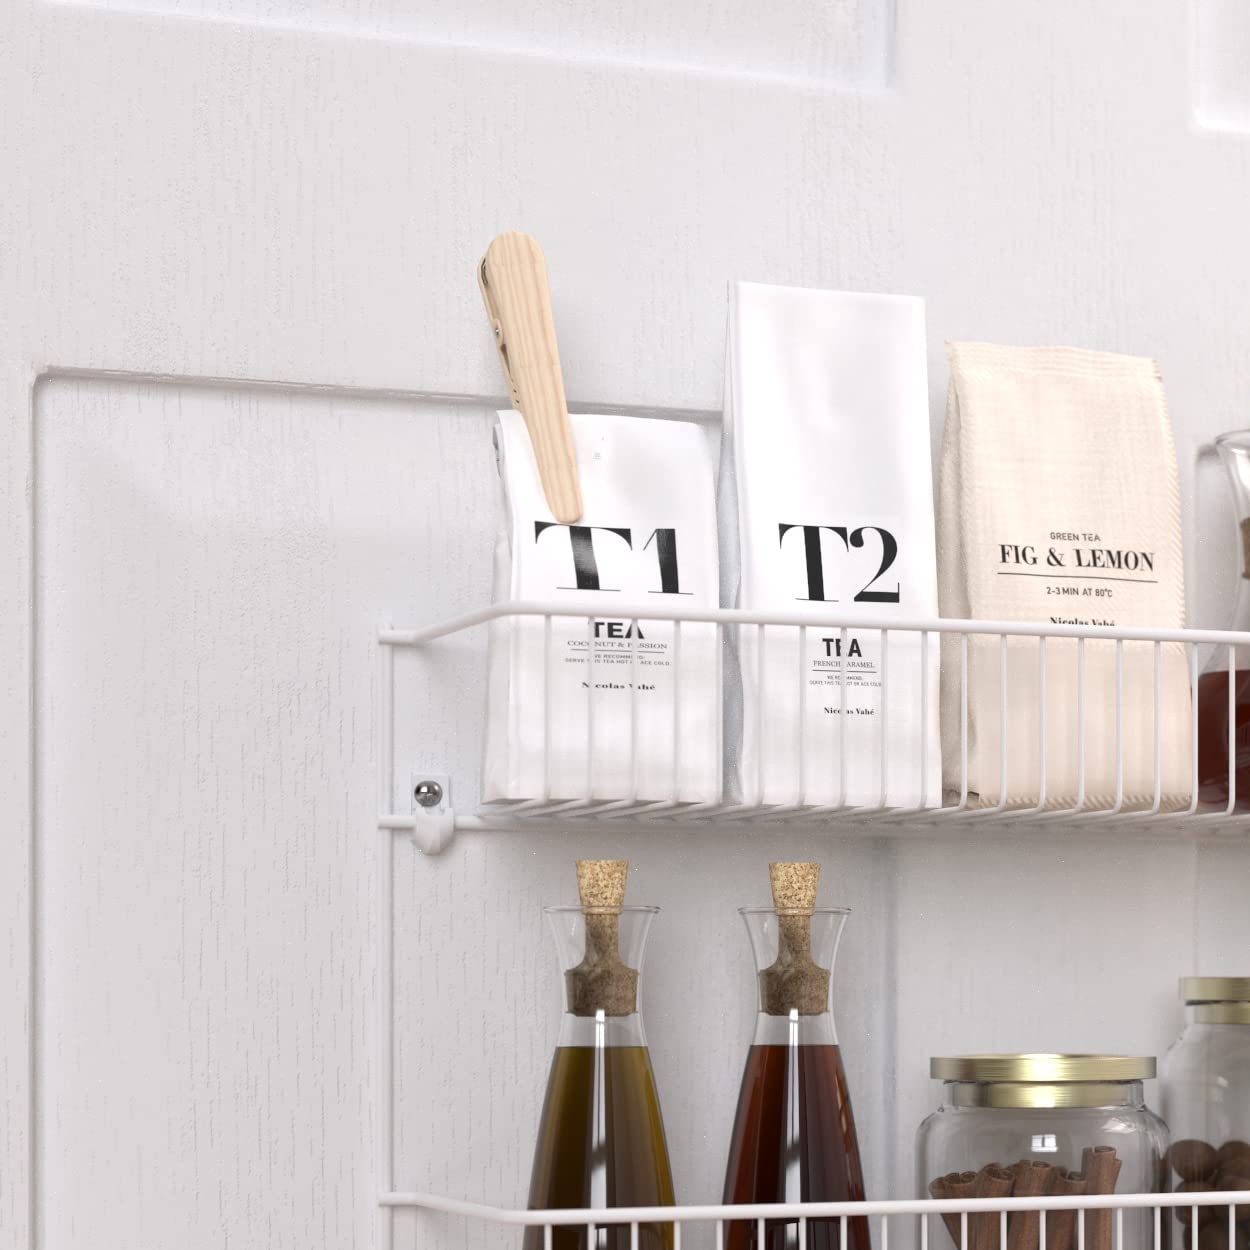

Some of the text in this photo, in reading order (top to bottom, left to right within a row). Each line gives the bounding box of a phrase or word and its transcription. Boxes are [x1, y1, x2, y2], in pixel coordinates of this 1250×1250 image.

[1050, 532, 1101, 542] GREEN TEA
[534, 520, 694, 595] T1
[778, 523, 900, 603] T2
[998, 543, 1155, 571] FIG & LEMON
[1046, 586, 1113, 598] 2-3 MIN AT 80°C
[589, 621, 645, 640] TEA
[567, 640, 617, 648] COCNUT
